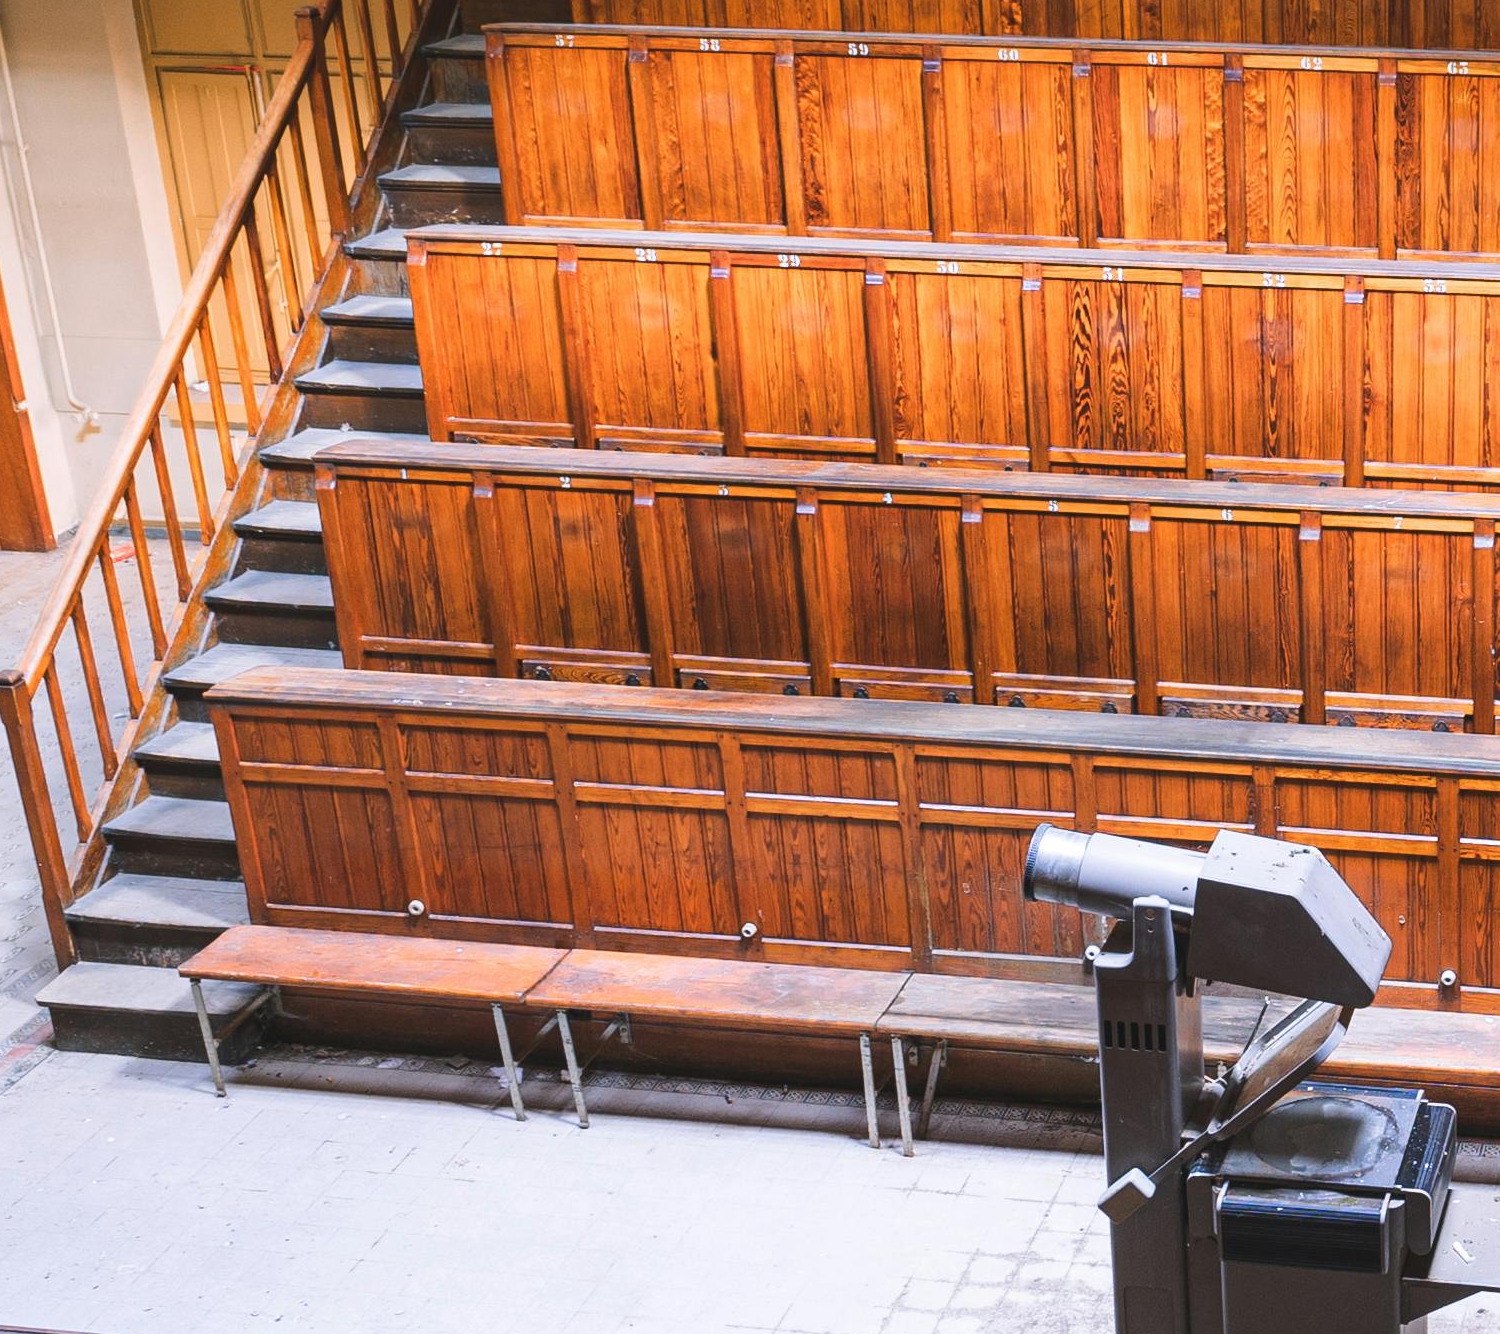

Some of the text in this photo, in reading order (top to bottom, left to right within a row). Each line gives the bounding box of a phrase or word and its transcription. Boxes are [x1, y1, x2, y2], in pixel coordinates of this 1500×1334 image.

[555, 35, 574, 47] 57
[700, 39, 720, 51] 58
[848, 44, 868, 55] 59
[998, 49, 1020, 60] 60
[1147, 53, 1167, 65] 61
[1300, 58, 1322, 69] 62
[1447, 62, 1470, 74] 63
[482, 243, 501, 255] 27
[635, 249, 657, 261] 28
[778, 255, 800, 267] 29
[936, 262, 958, 273] 30
[1102, 268, 1124, 281] 31
[1263, 274, 1285, 287] 32
[1423, 280, 1446, 292] 33
[402, 469, 408, 479] 1
[560, 477, 570, 488] 2
[718, 485, 728, 495] 3
[882, 492, 892, 504] 4
[1048, 500, 1059, 512] 5
[1222, 509, 1233, 521] 6
